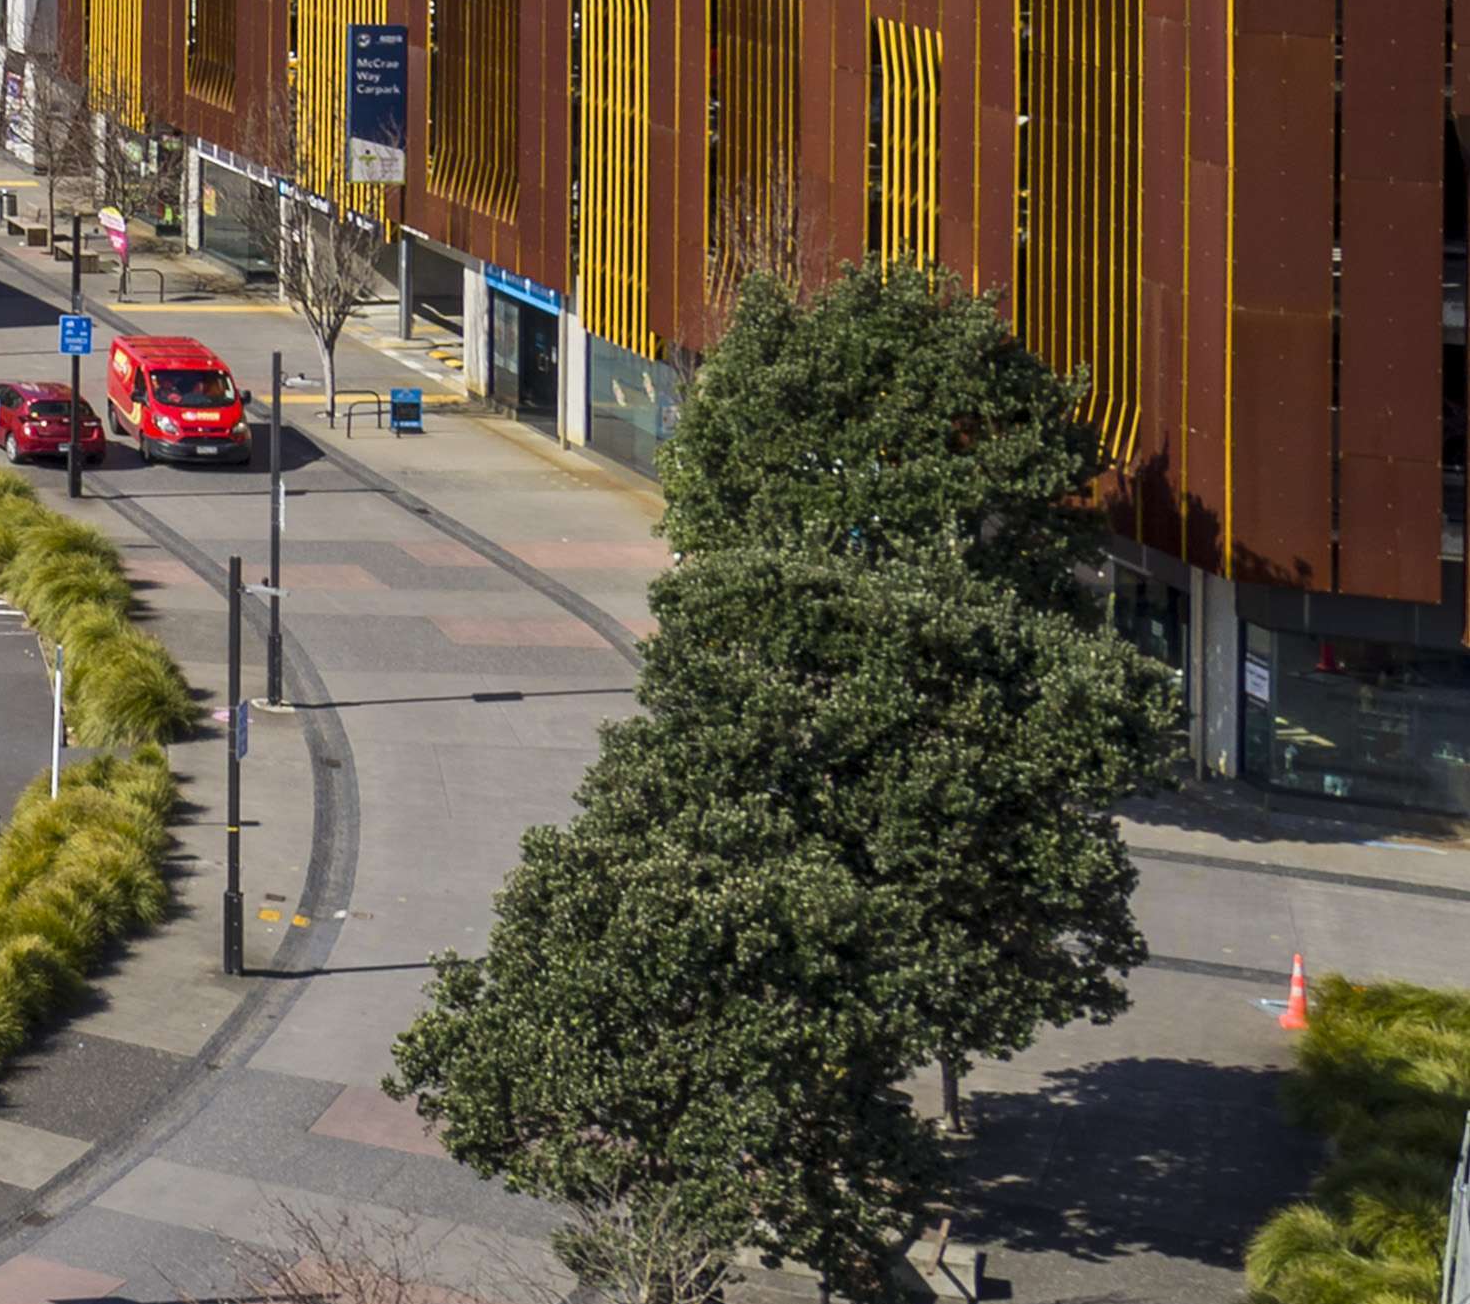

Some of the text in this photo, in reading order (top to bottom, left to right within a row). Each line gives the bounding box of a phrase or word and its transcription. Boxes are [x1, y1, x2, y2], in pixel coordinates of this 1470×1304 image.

[356, 58, 400, 70] McCrae
[356, 71, 381, 84] Way
[356, 84, 400, 96] Carpark
